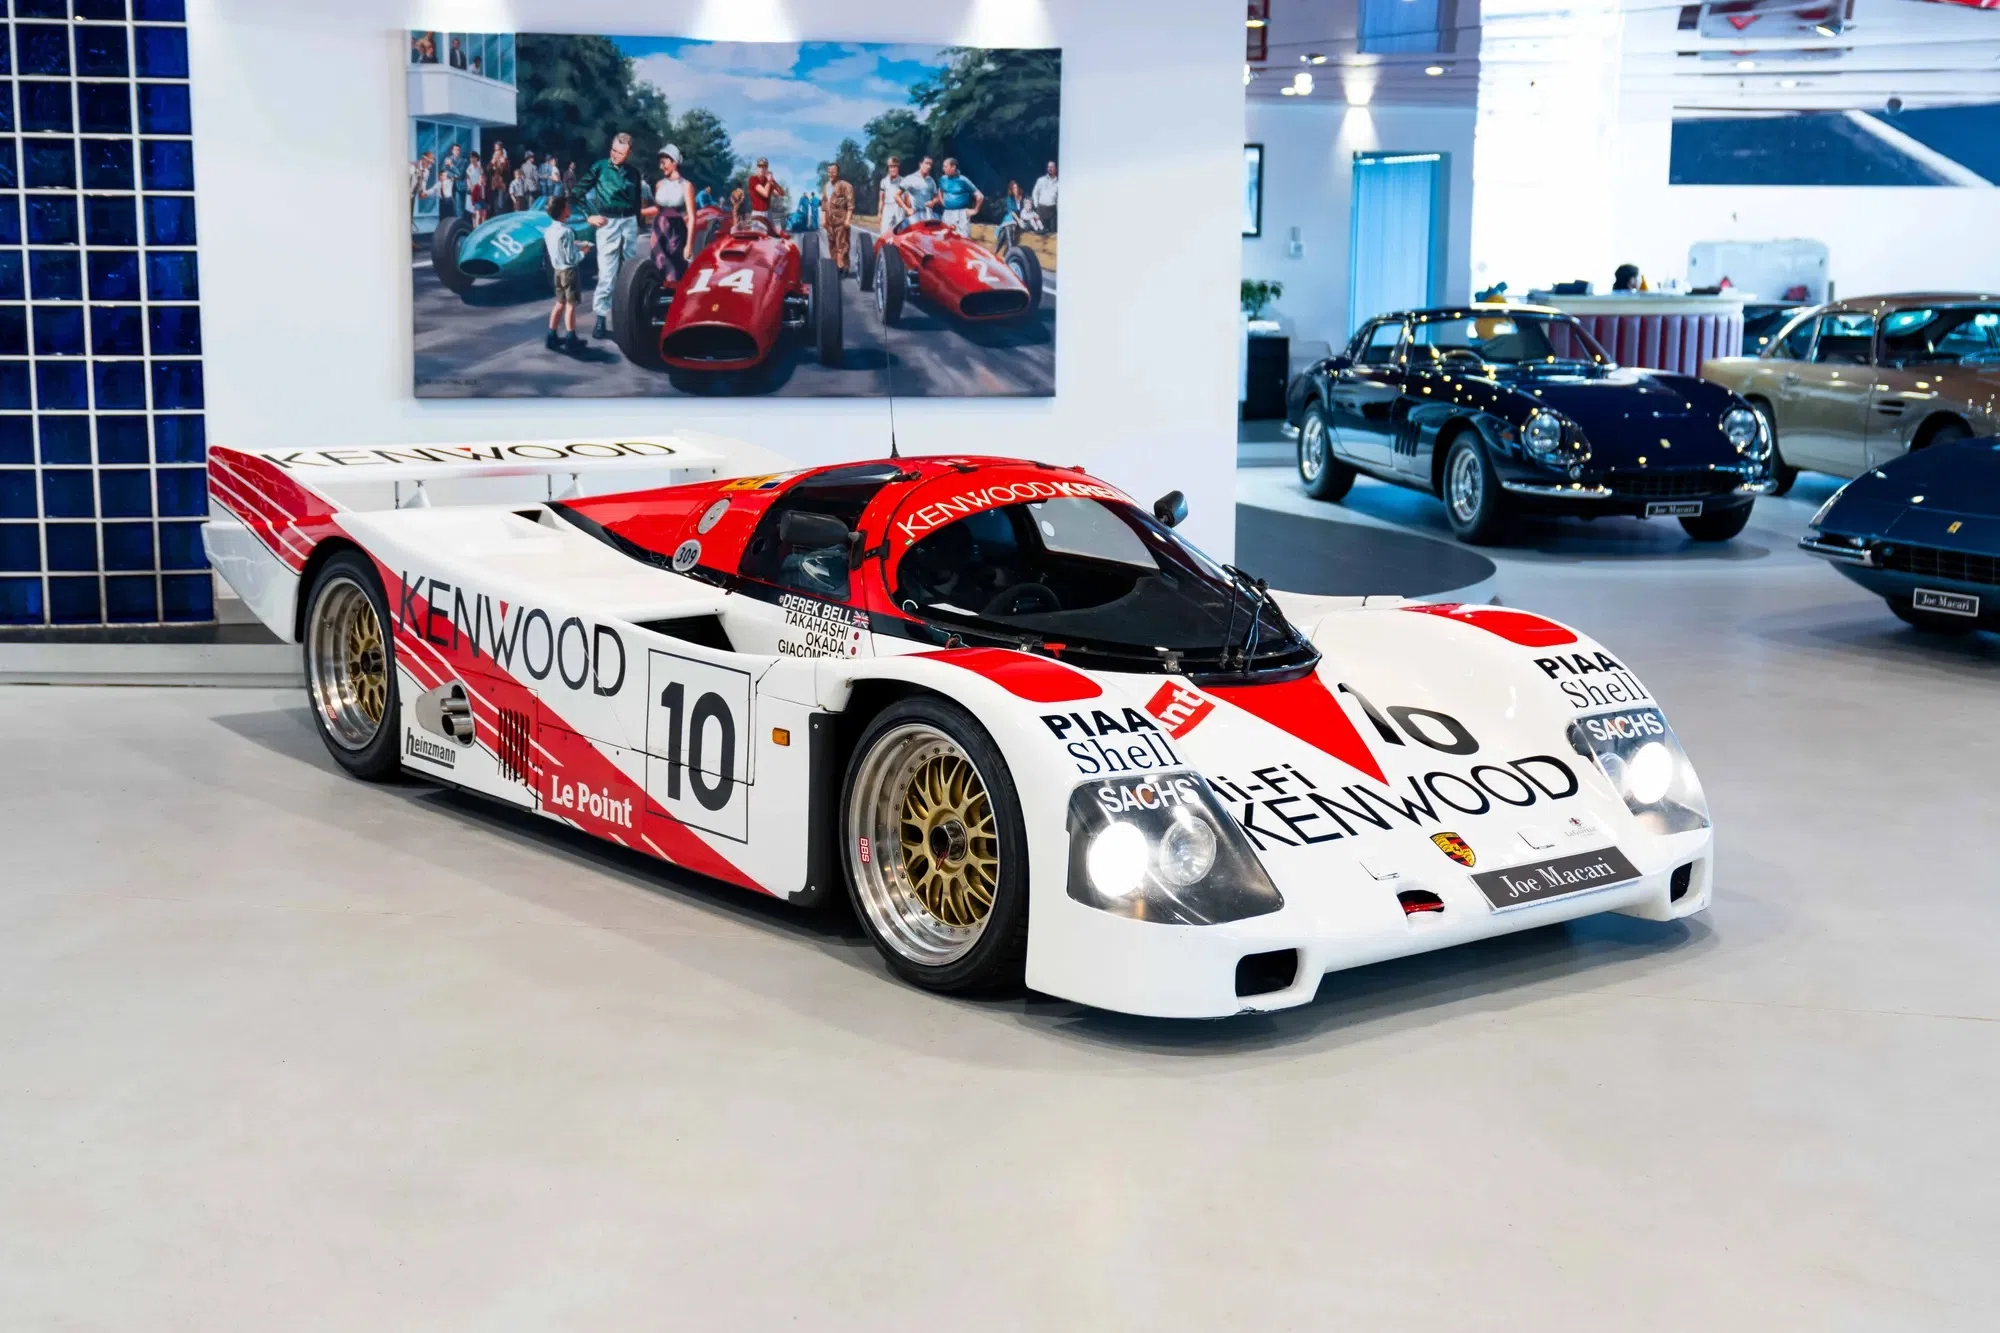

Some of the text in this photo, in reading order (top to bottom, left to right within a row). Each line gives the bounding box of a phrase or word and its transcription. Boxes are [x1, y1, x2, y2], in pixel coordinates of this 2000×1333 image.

[490, 233, 523, 257] 18
[686, 268, 754, 295] 14
[967, 260, 1000, 282] 2
[262, 443, 676, 469] KENWOOD
[897, 482, 1057, 538] KENWOOD
[677, 547, 698, 564] 309
[783, 593, 852, 625] DEREK BELL
[1921, 593, 1937, 605] Joe
[399, 570, 626, 697] KENWOOD
[785, 610, 849, 640] TAKAHASHI
[805, 632, 845, 656] OKADA
[1533, 652, 1625, 679] PIAA
[1560, 672, 1649, 708] Shell
[1039, 707, 1159, 740] PIAA
[1337, 682, 1480, 756] 10
[1586, 713, 1664, 741] SACHS
[405, 727, 456, 764] heinzmann
[660, 681, 736, 812] 10
[1067, 732, 1183, 775] Shell
[551, 774, 633, 828] Le Point
[1098, 778, 1201, 813] SACHS
[1231, 754, 1580, 852] KENWOOD
[860, 838, 870, 863] BBS
[1499, 857, 1616, 898] Joe Macari
